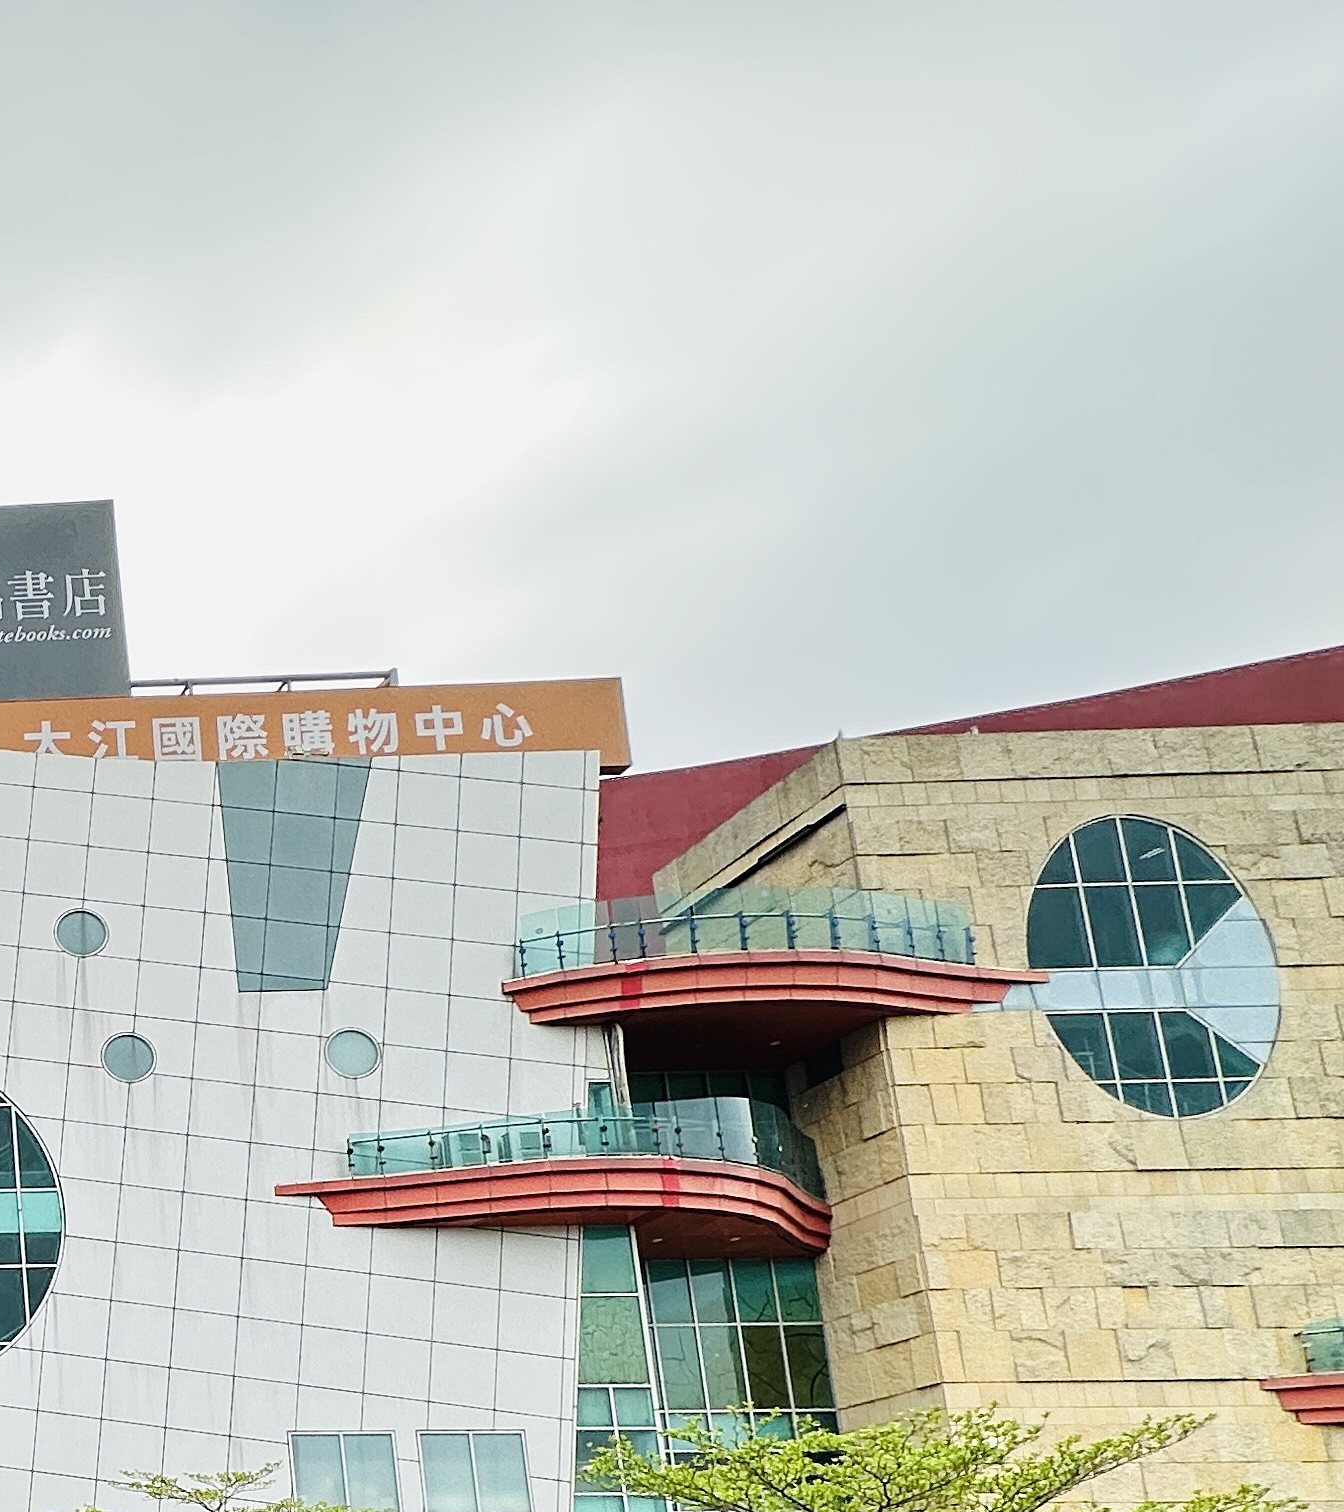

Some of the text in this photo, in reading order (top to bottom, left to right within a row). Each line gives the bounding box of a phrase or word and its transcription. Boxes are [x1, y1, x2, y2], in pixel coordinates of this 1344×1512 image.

[23, 702, 535, 762] 大江國際購物中心
